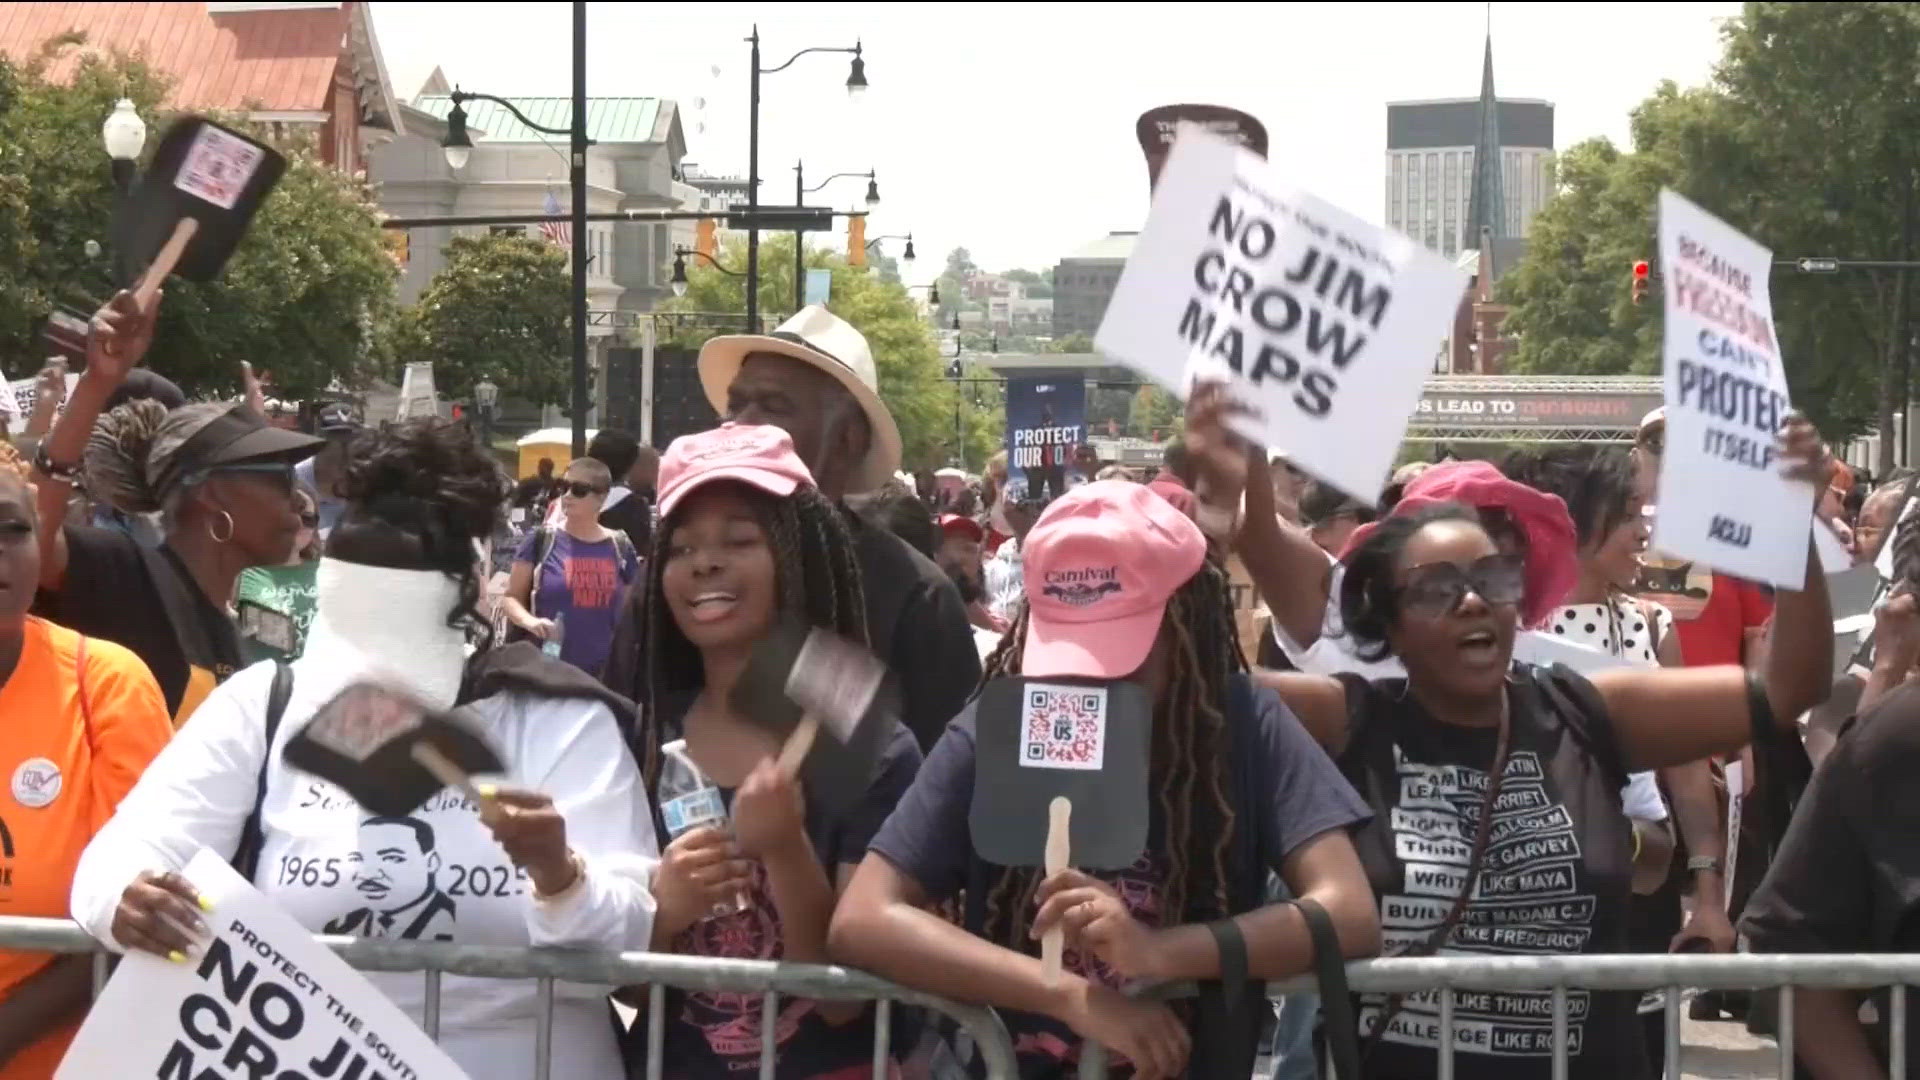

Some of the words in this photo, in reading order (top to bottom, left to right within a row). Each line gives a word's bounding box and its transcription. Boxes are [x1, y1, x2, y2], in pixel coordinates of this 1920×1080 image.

[1209, 197, 1276, 259] NO
[1285, 247, 1392, 329] JIM
[1194, 251, 1366, 368] CROW
[1178, 298, 1336, 418] MAPS
[1437, 400, 1485, 413] LEAD
[1489, 400, 1515, 413] TO
[1014, 425, 1081, 446] PROTECT
[1014, 447, 1042, 468] OUR
[1703, 428, 1774, 471] ITSELF
[1408, 784, 1441, 800] LEA
[1501, 838, 1569, 865] GARVEY
[278, 856, 341, 888] 1965
[1415, 870, 1466, 889] WRIT
[1483, 875, 1516, 892] LIKE
[1519, 871, 1567, 891] MAYA
[1493, 906, 1556, 923] MADAM
[196, 937, 305, 1041] NO
[229, 919, 323, 997] PROTECT
[325, 994, 364, 1034] THE
[1494, 1032, 1531, 1049] LIKE
